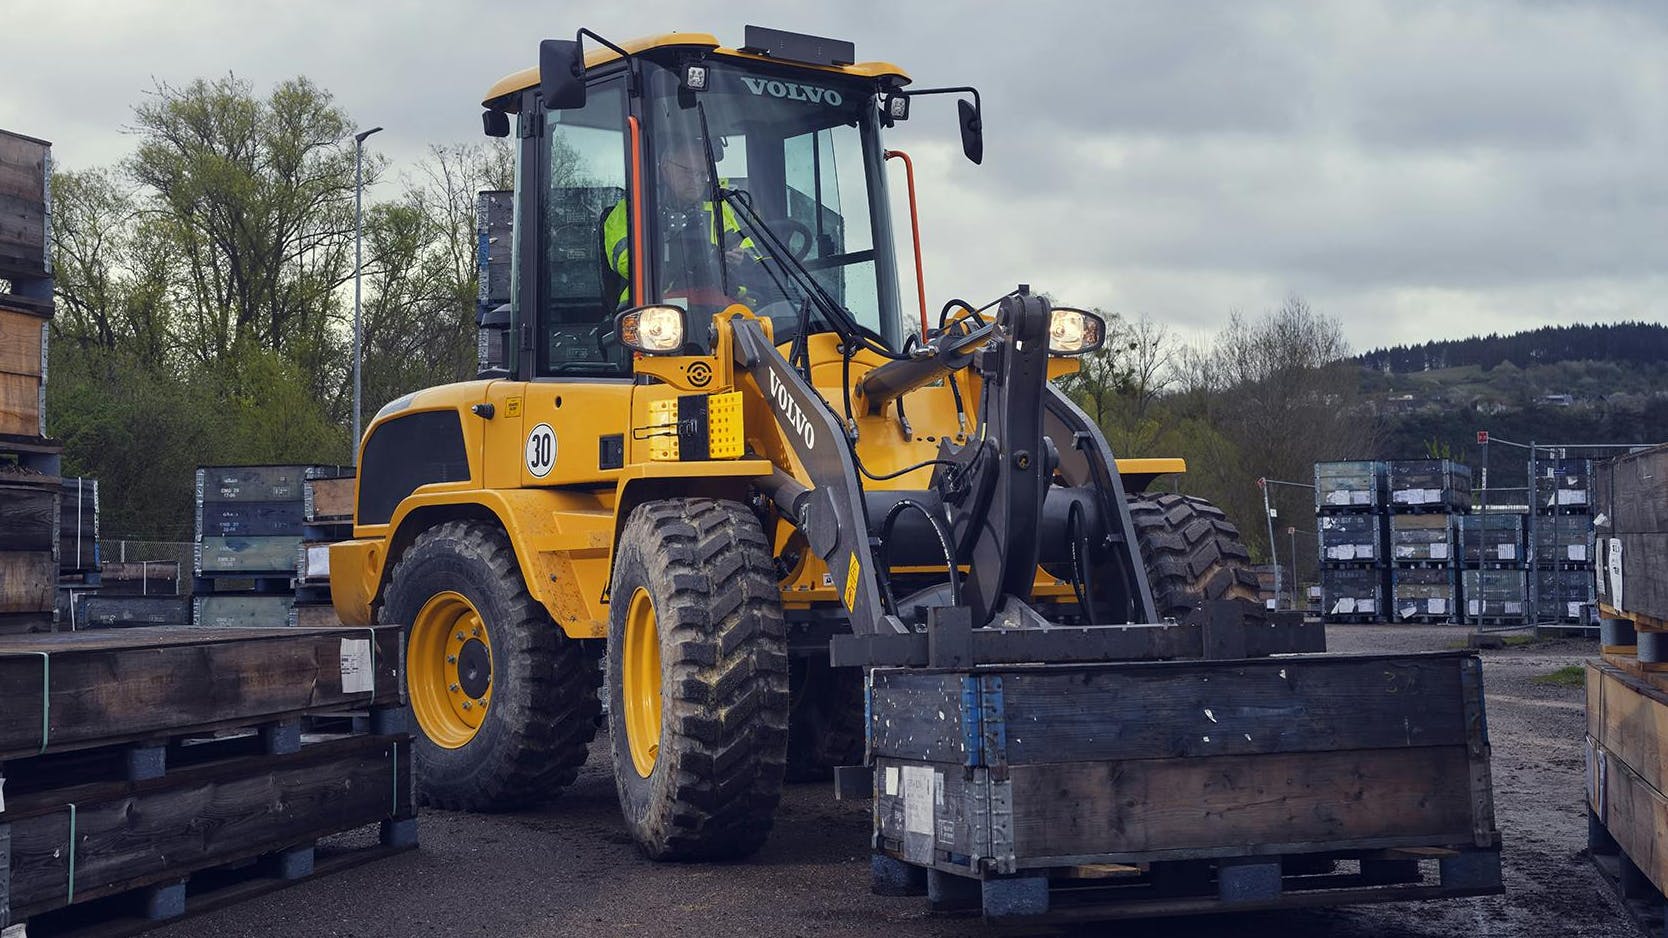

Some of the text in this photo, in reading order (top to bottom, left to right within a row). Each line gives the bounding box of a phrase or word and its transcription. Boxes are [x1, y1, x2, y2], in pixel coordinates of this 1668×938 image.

[741, 77, 842, 106] VOLVO
[769, 366, 814, 450] VOLVO
[531, 433, 550, 468] 30
